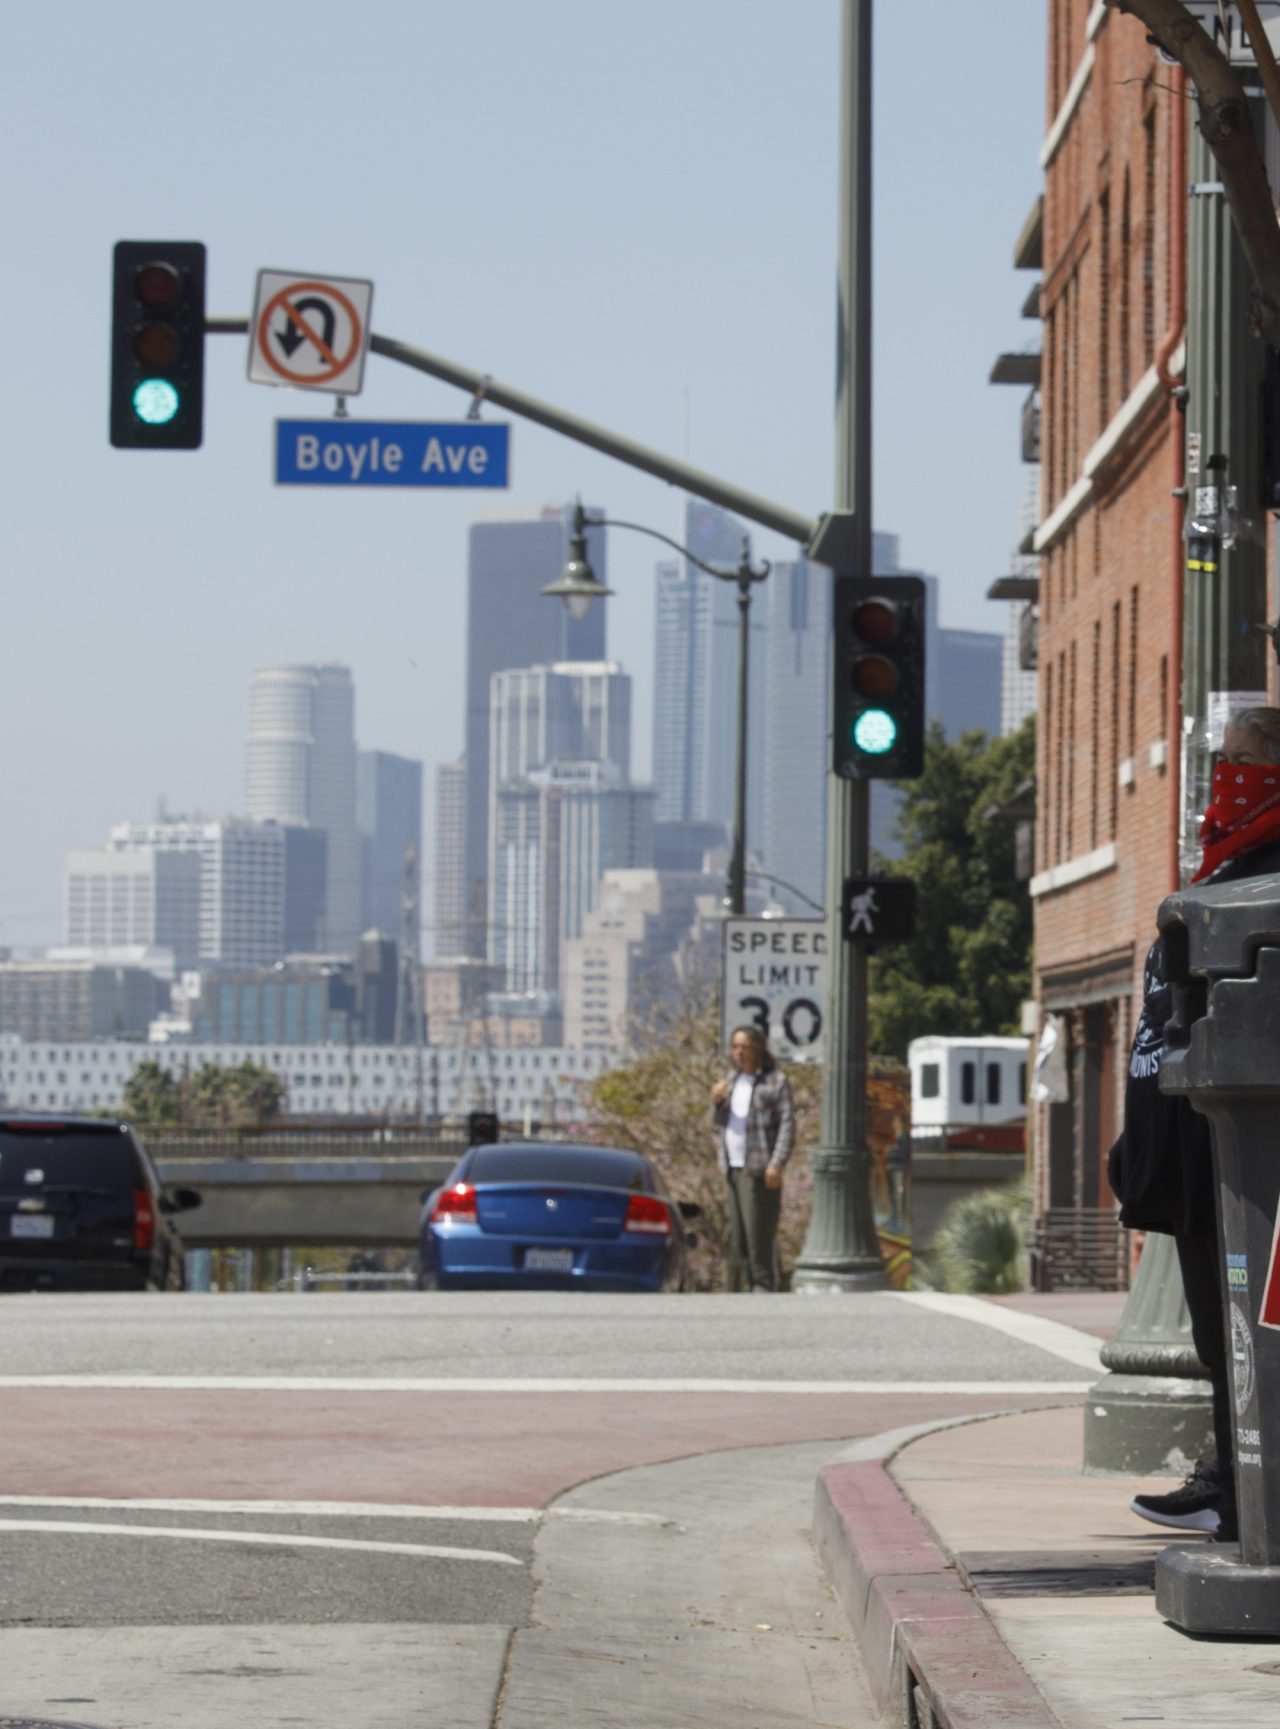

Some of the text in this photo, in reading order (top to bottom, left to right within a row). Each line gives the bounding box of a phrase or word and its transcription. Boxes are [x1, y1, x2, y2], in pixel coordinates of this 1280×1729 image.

[296, 434, 488, 480] Boyle Ave
[731, 931, 828, 956] SPEED
[739, 964, 820, 986] LIMIT
[739, 996, 822, 1047] 30
